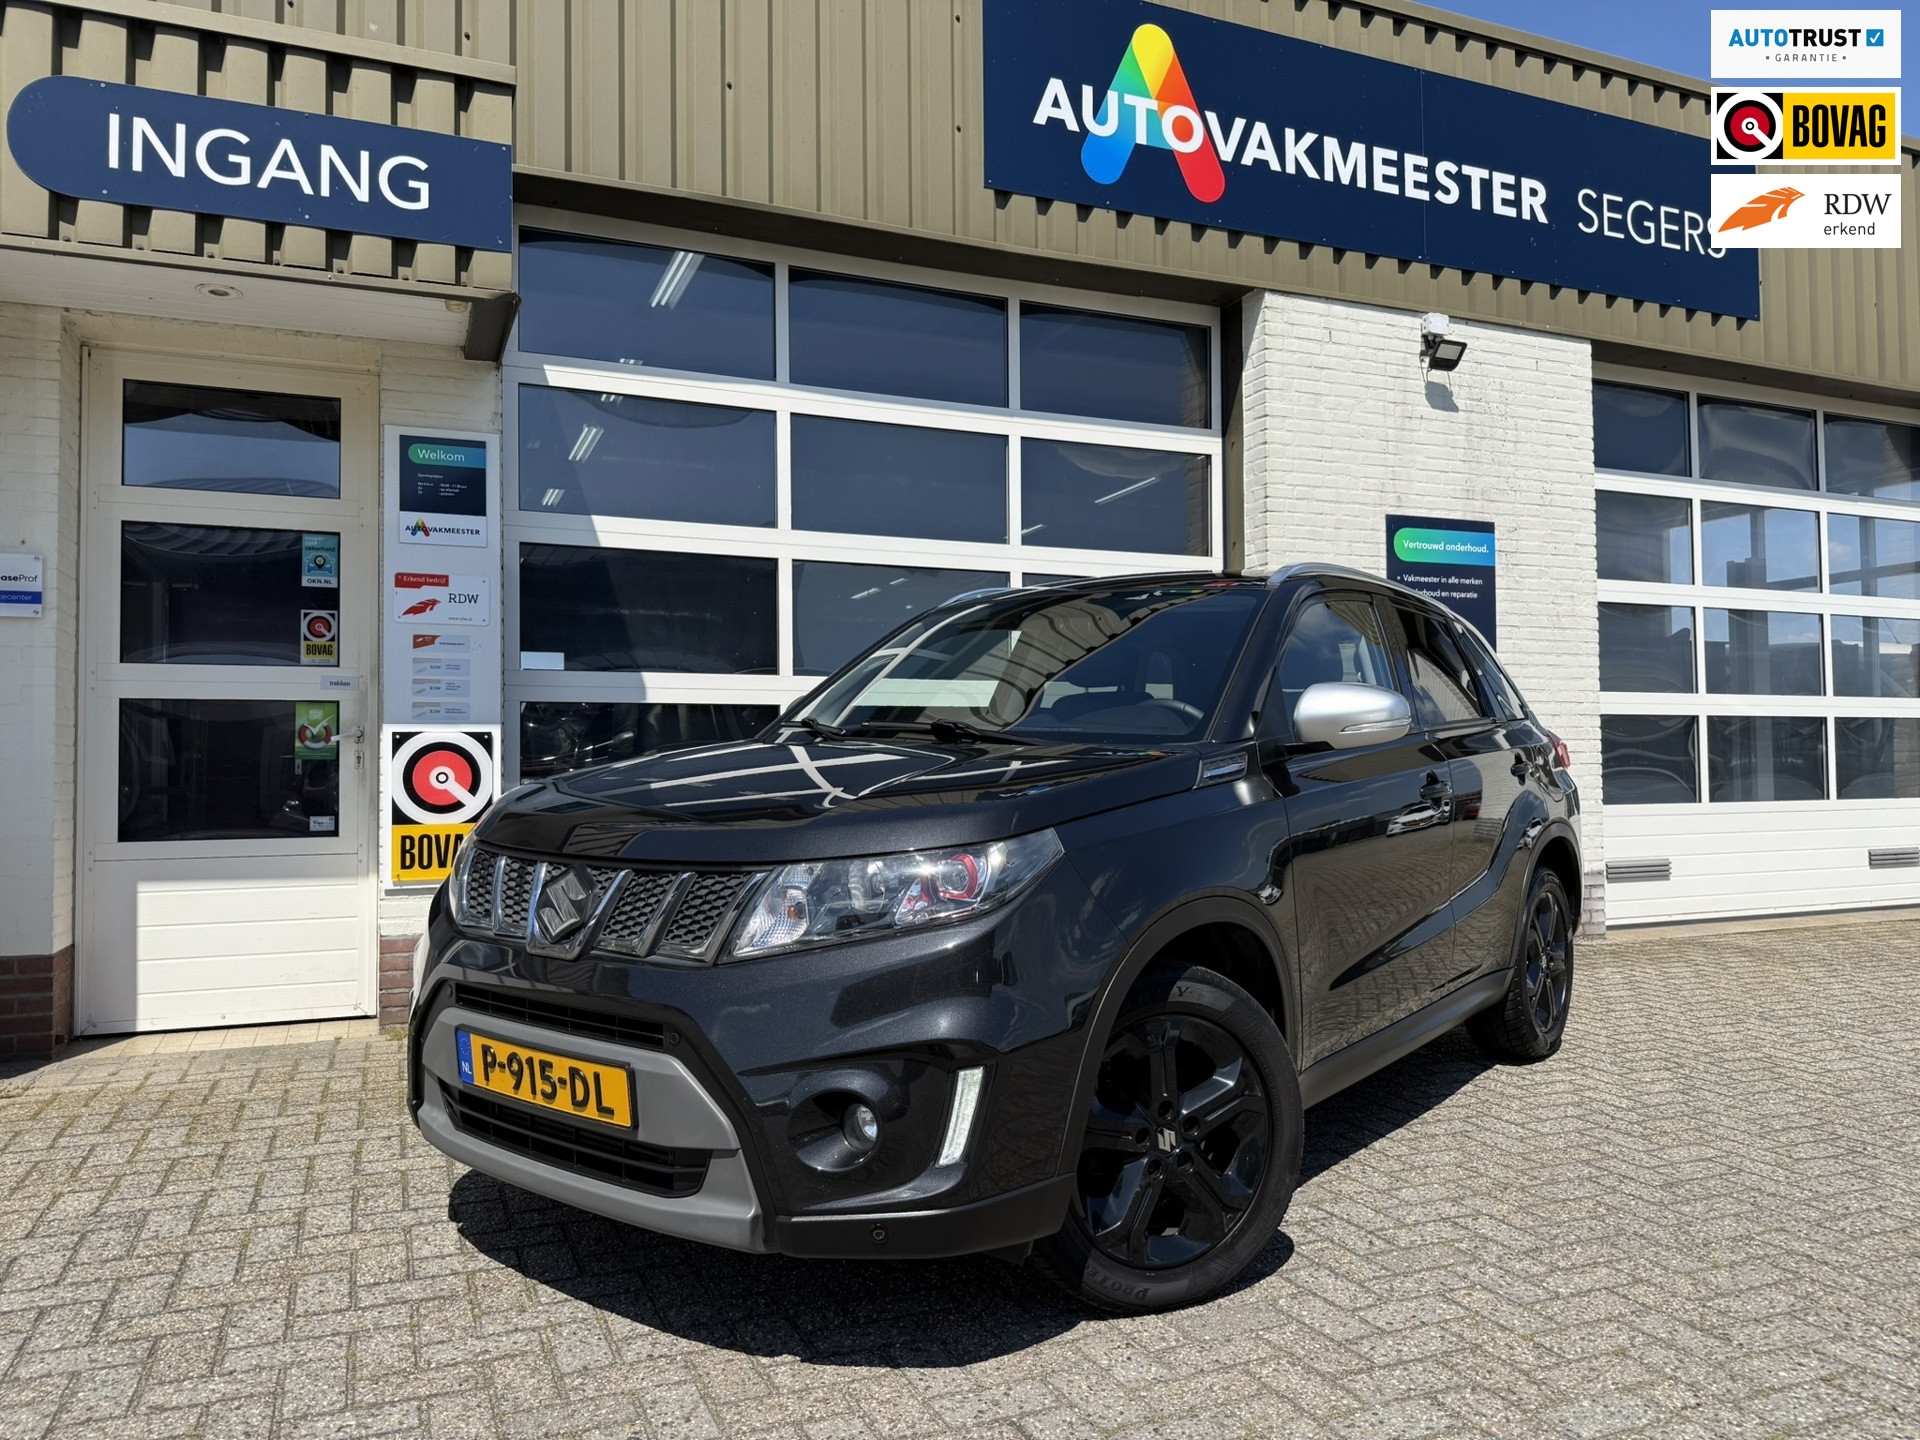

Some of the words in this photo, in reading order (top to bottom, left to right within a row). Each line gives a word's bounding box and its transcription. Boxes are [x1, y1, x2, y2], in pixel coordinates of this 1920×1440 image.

[1033, 77, 1549, 225] AUTOVAKMEESTER
[108, 112, 430, 211] INGANG
[417, 448, 465, 462] Welkom
[405, 525, 480, 535] AUTOVAKMEESTER
[1402, 540, 1444, 551] Vertrouwd
[1445, 543, 1489, 553] onderhoud.
[403, 575, 425, 583] Erkend
[426, 576, 446, 584] bedrijf
[1402, 574, 1440, 583] Vakmeester
[1448, 576, 1459, 584] alle
[1460, 577, 1483, 585] merken
[448, 593, 479, 604] RDW
[1450, 590, 1478, 600] reparatie
[306, 643, 333, 656] BOVAG
[400, 833, 464, 870] BOV
[461, 1060, 473, 1075] NL
[481, 1043, 615, 1116] P-915-DL
